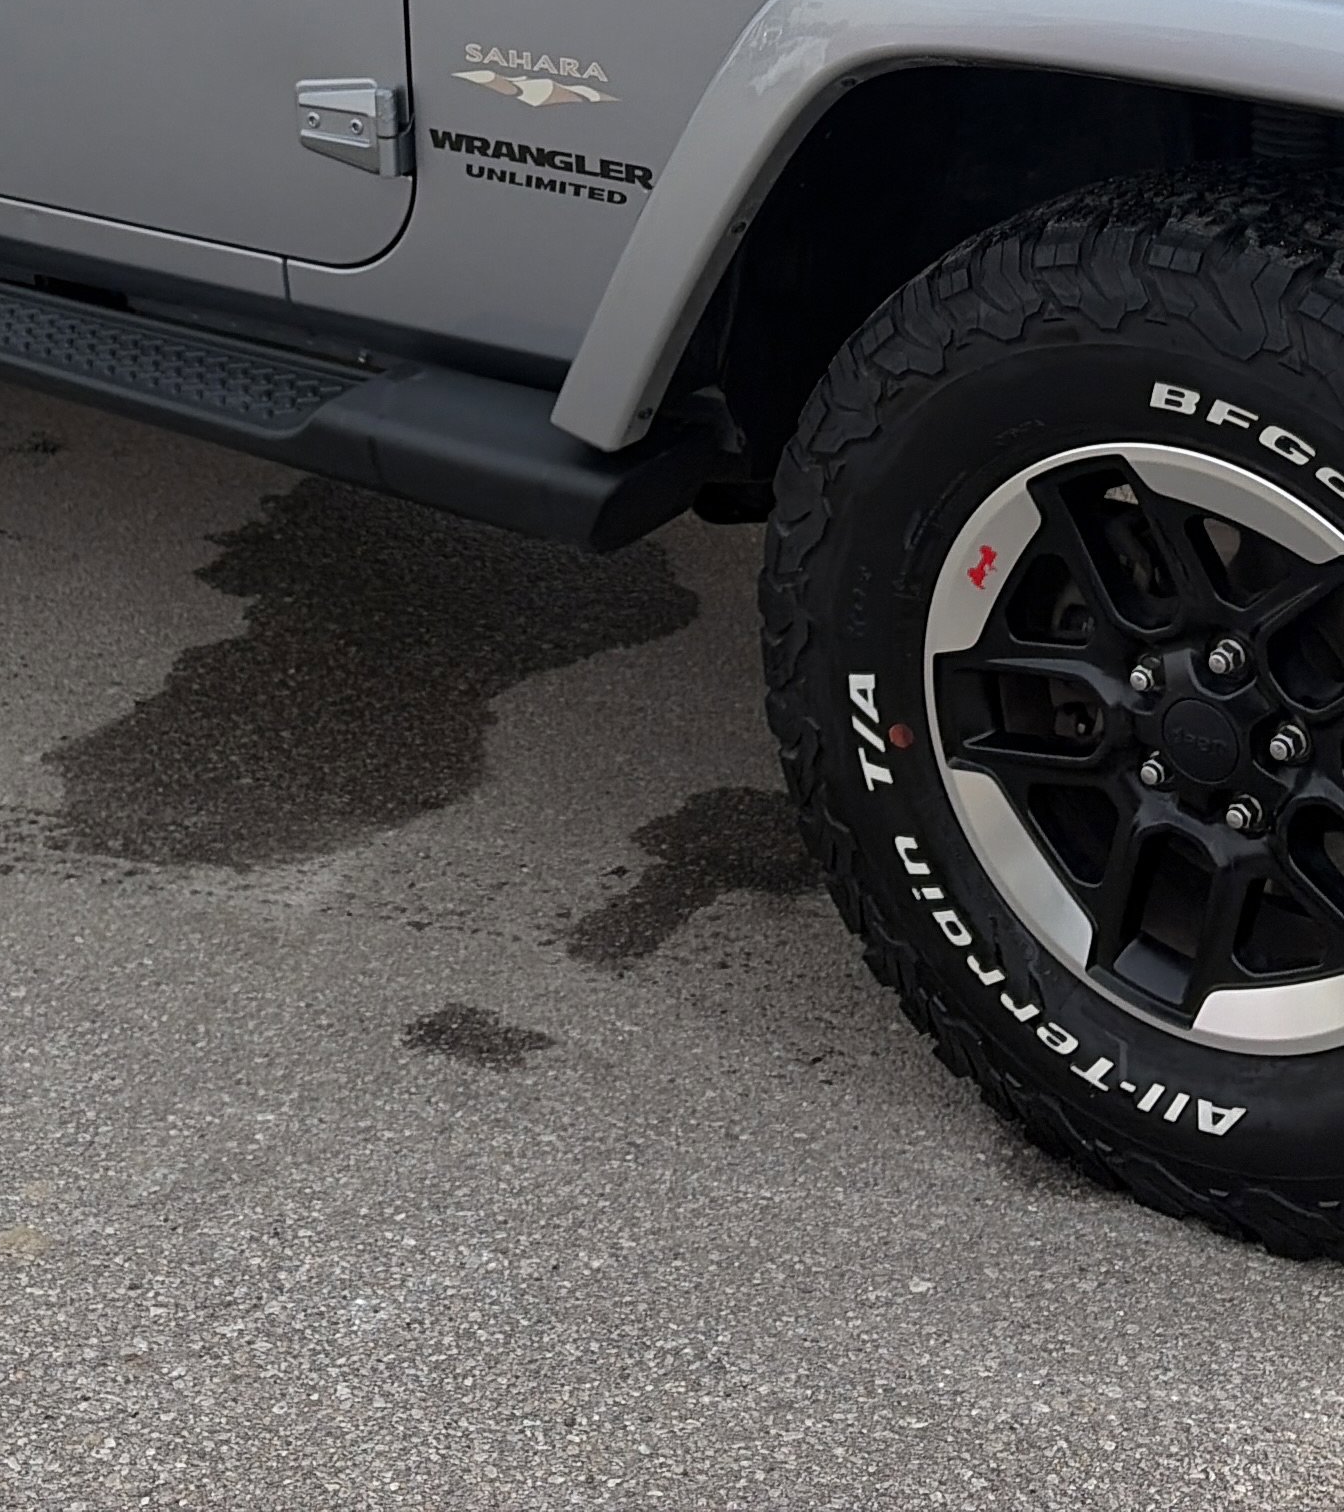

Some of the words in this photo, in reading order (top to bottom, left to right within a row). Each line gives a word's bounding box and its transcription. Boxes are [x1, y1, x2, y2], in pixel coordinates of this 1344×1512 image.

[464, 42, 608, 82] SAHARA
[428, 128, 654, 190] WRANGLER
[465, 163, 627, 205] UNLIMITED
[848, 673, 895, 792] T/A
[894, 835, 1250, 1137] All-Terrain
